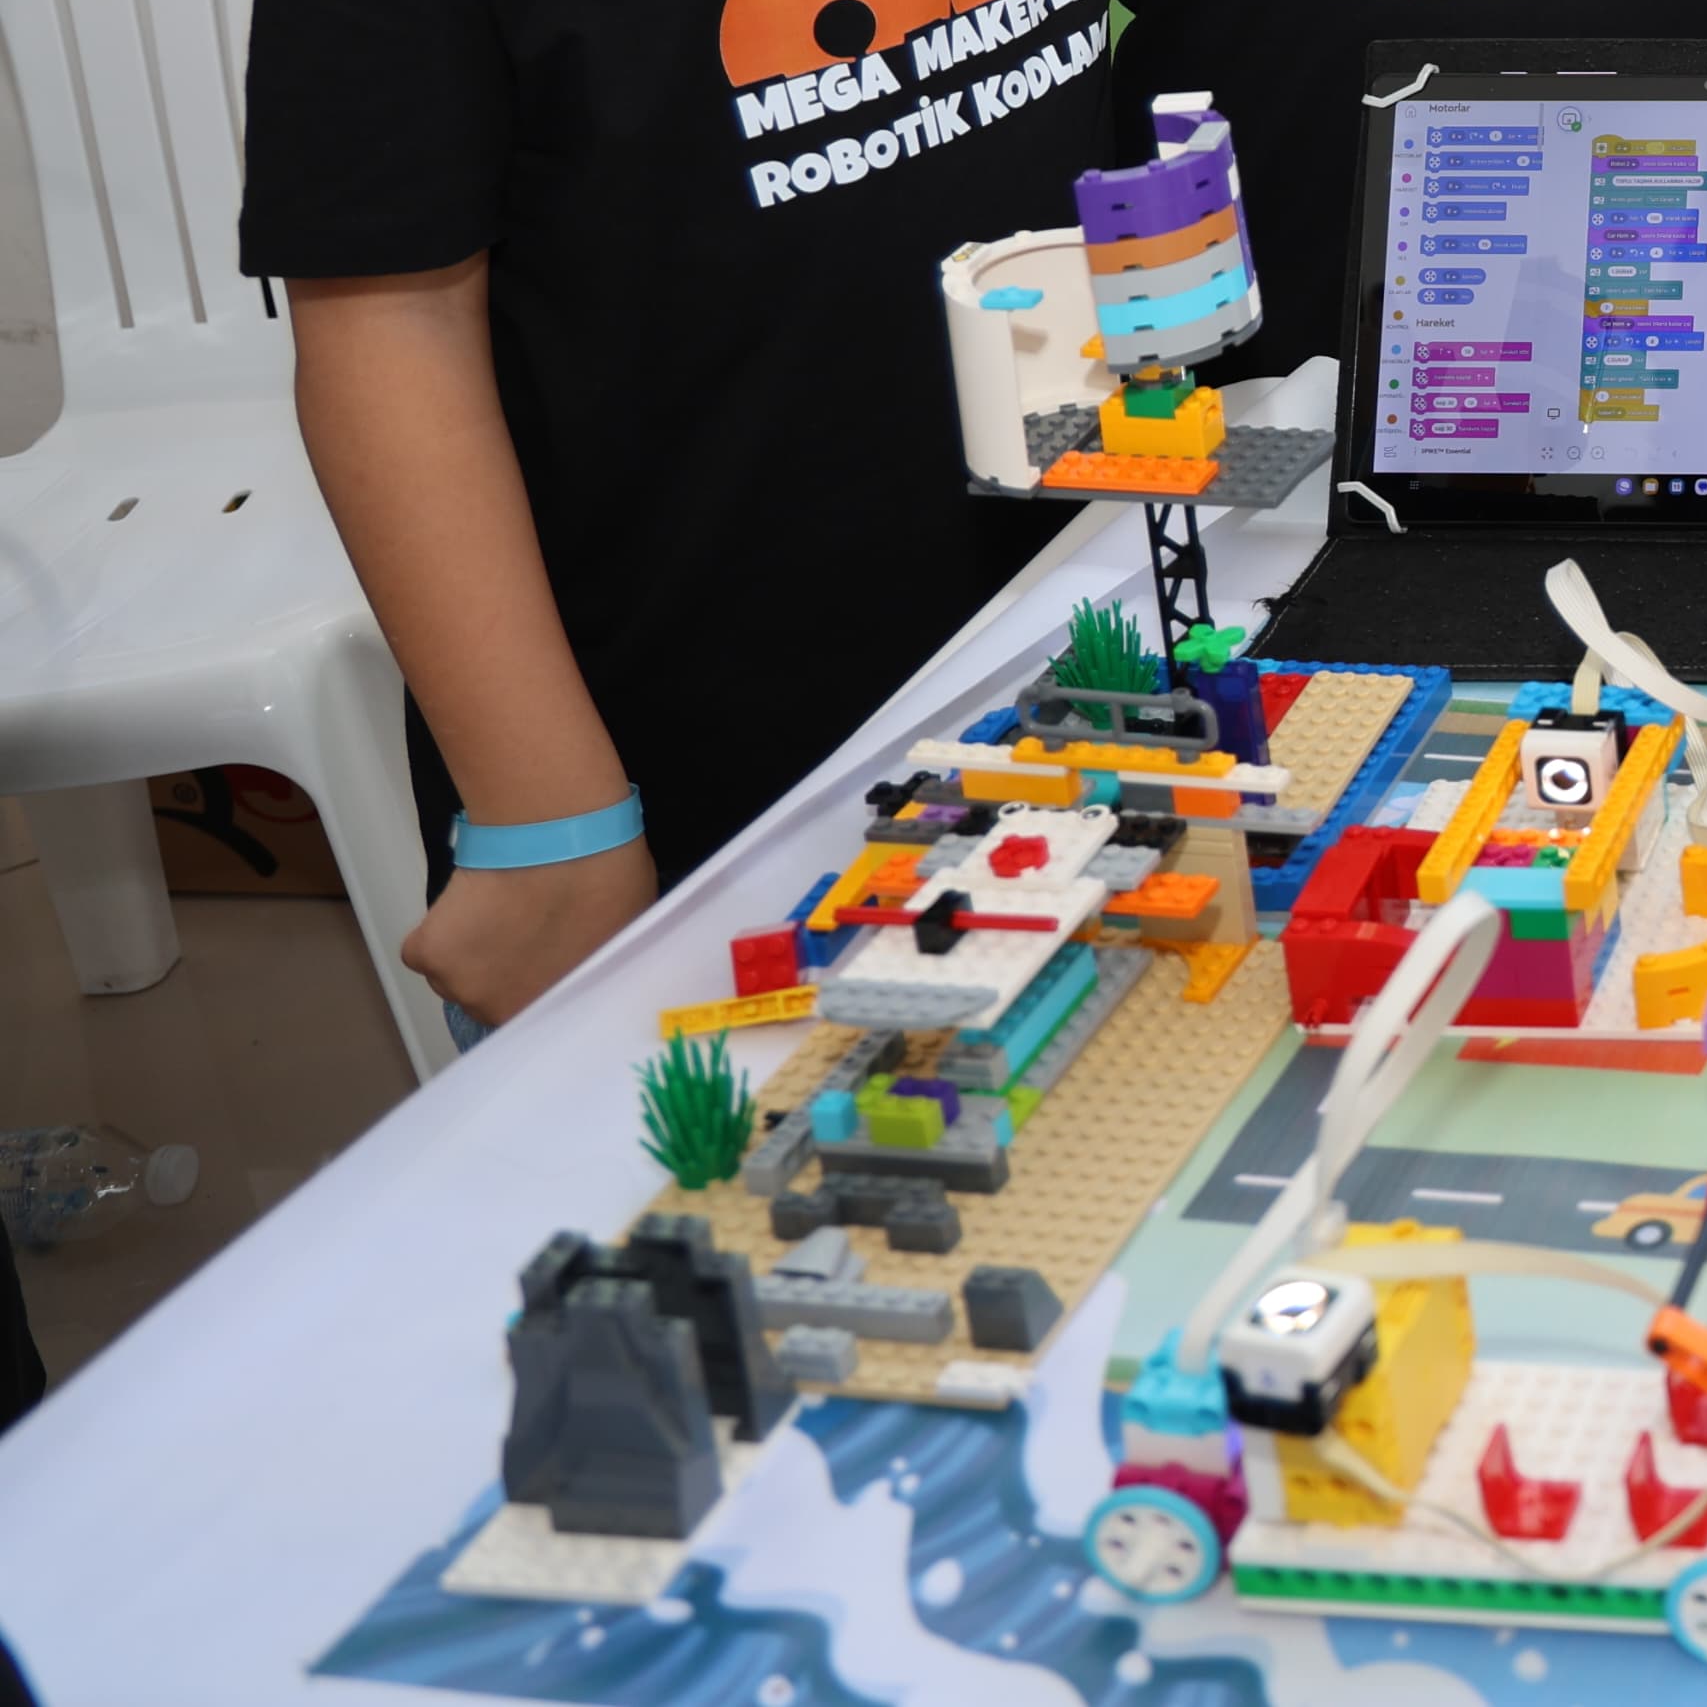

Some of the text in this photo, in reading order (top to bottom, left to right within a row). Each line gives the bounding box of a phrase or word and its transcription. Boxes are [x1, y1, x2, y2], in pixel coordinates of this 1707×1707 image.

[735, 52, 901, 139] MEGA
[1429, 103, 1470, 113] Motorlar
[750, 90, 972, 208] ROBOTİK
[1416, 318, 1455, 328] Hareket
